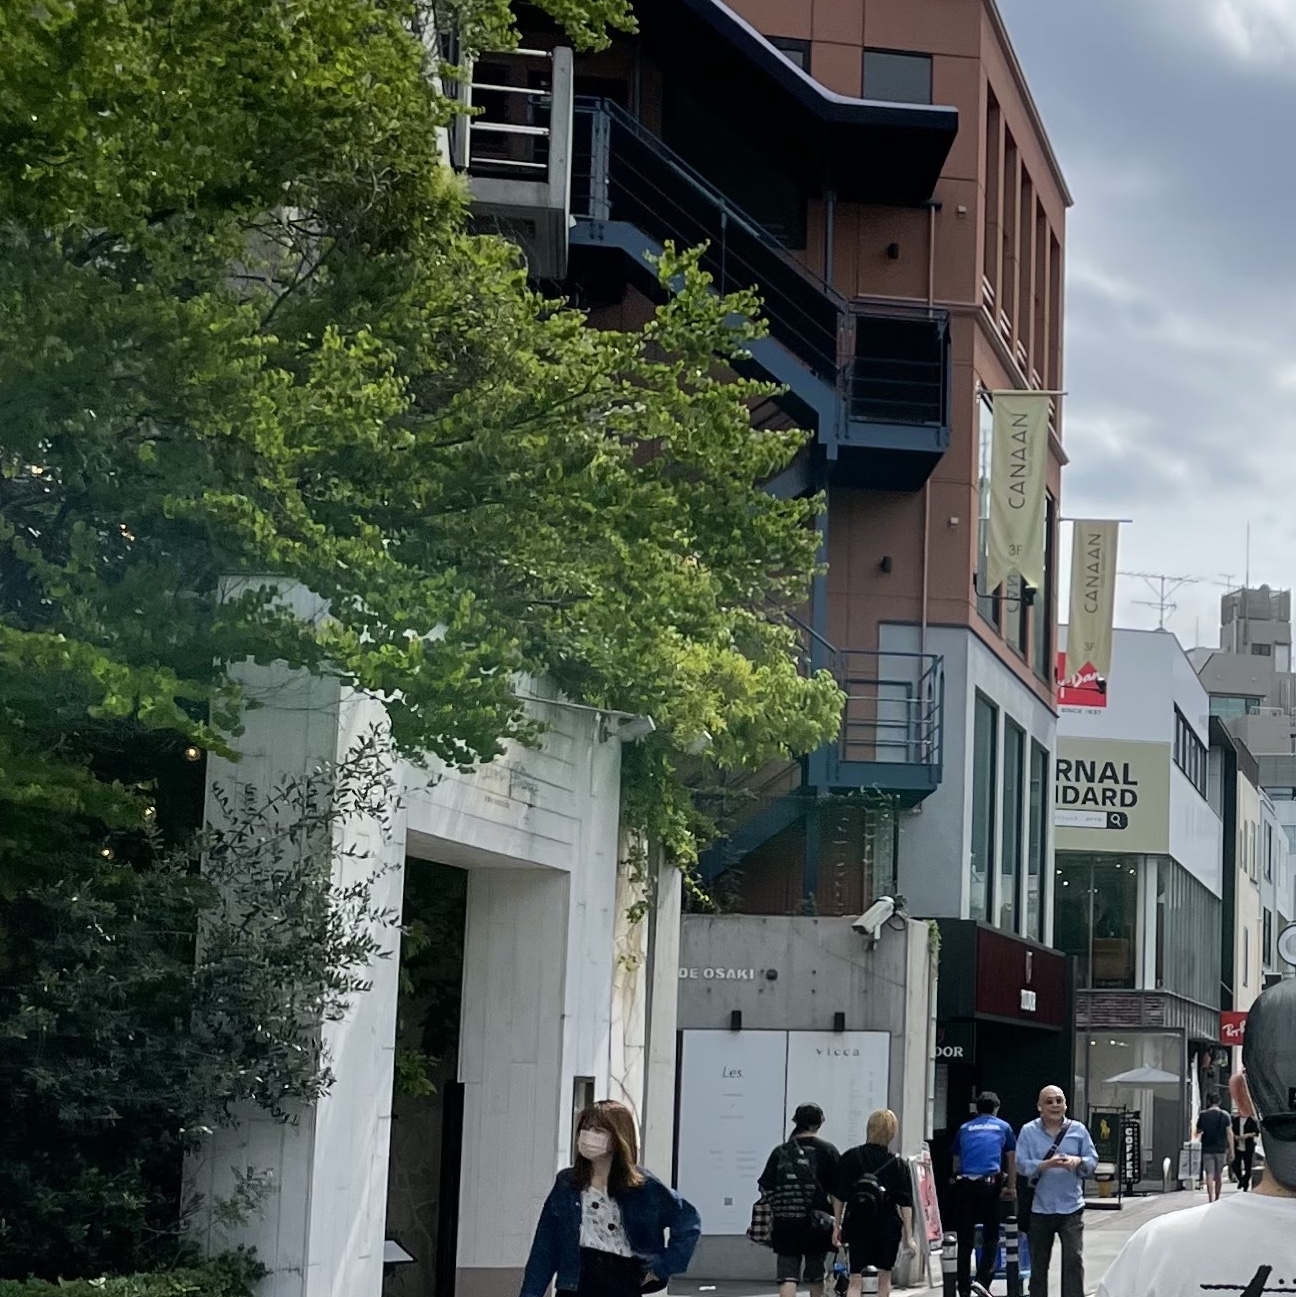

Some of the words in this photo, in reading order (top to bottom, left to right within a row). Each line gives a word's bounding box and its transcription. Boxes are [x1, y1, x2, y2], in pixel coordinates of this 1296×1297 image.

[1008, 413, 1028, 510] CANAAN
[1008, 544, 1023, 556] 3F
[1083, 532, 1102, 614] CANAAN
[703, 967, 755, 980] OSAKI
